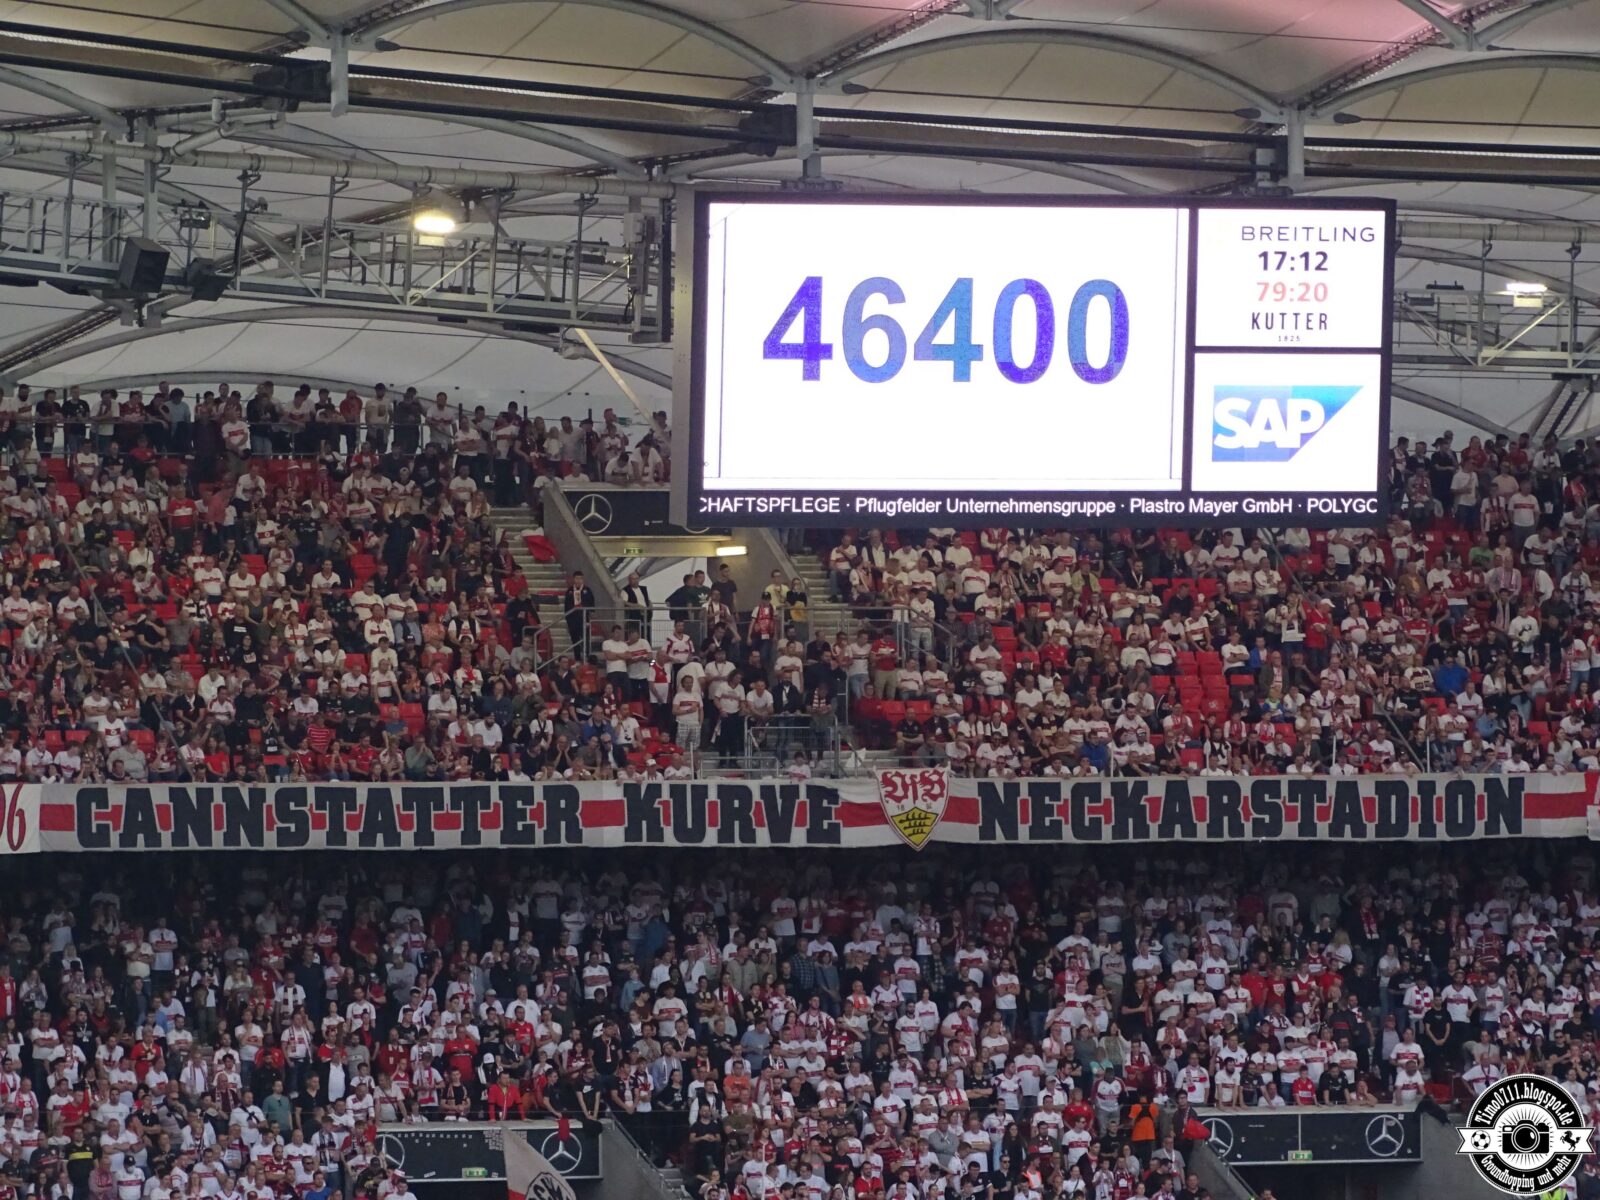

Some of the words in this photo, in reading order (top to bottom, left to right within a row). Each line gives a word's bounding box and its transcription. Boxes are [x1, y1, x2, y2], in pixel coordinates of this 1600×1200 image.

[1241, 225, 1376, 243] BREITLING
[1257, 251, 1329, 272] 17:12
[1256, 281, 1329, 303] 79:20
[762, 275, 1130, 385] 46400
[1251, 312, 1328, 331] KUTTER
[1213, 397, 1325, 449] SAP
[855, 497, 942, 517] Pflugfelder
[946, 497, 1116, 517] Unternehmensgruppe
[1130, 497, 1185, 514] Plastro
[1188, 497, 1239, 517] Mayer
[1242, 497, 1293, 514] GmbH
[76, 784, 584, 850] CANNSTATTER
[624, 783, 841, 845] KURVE
[979, 777, 1526, 842] NECKARSTADION
